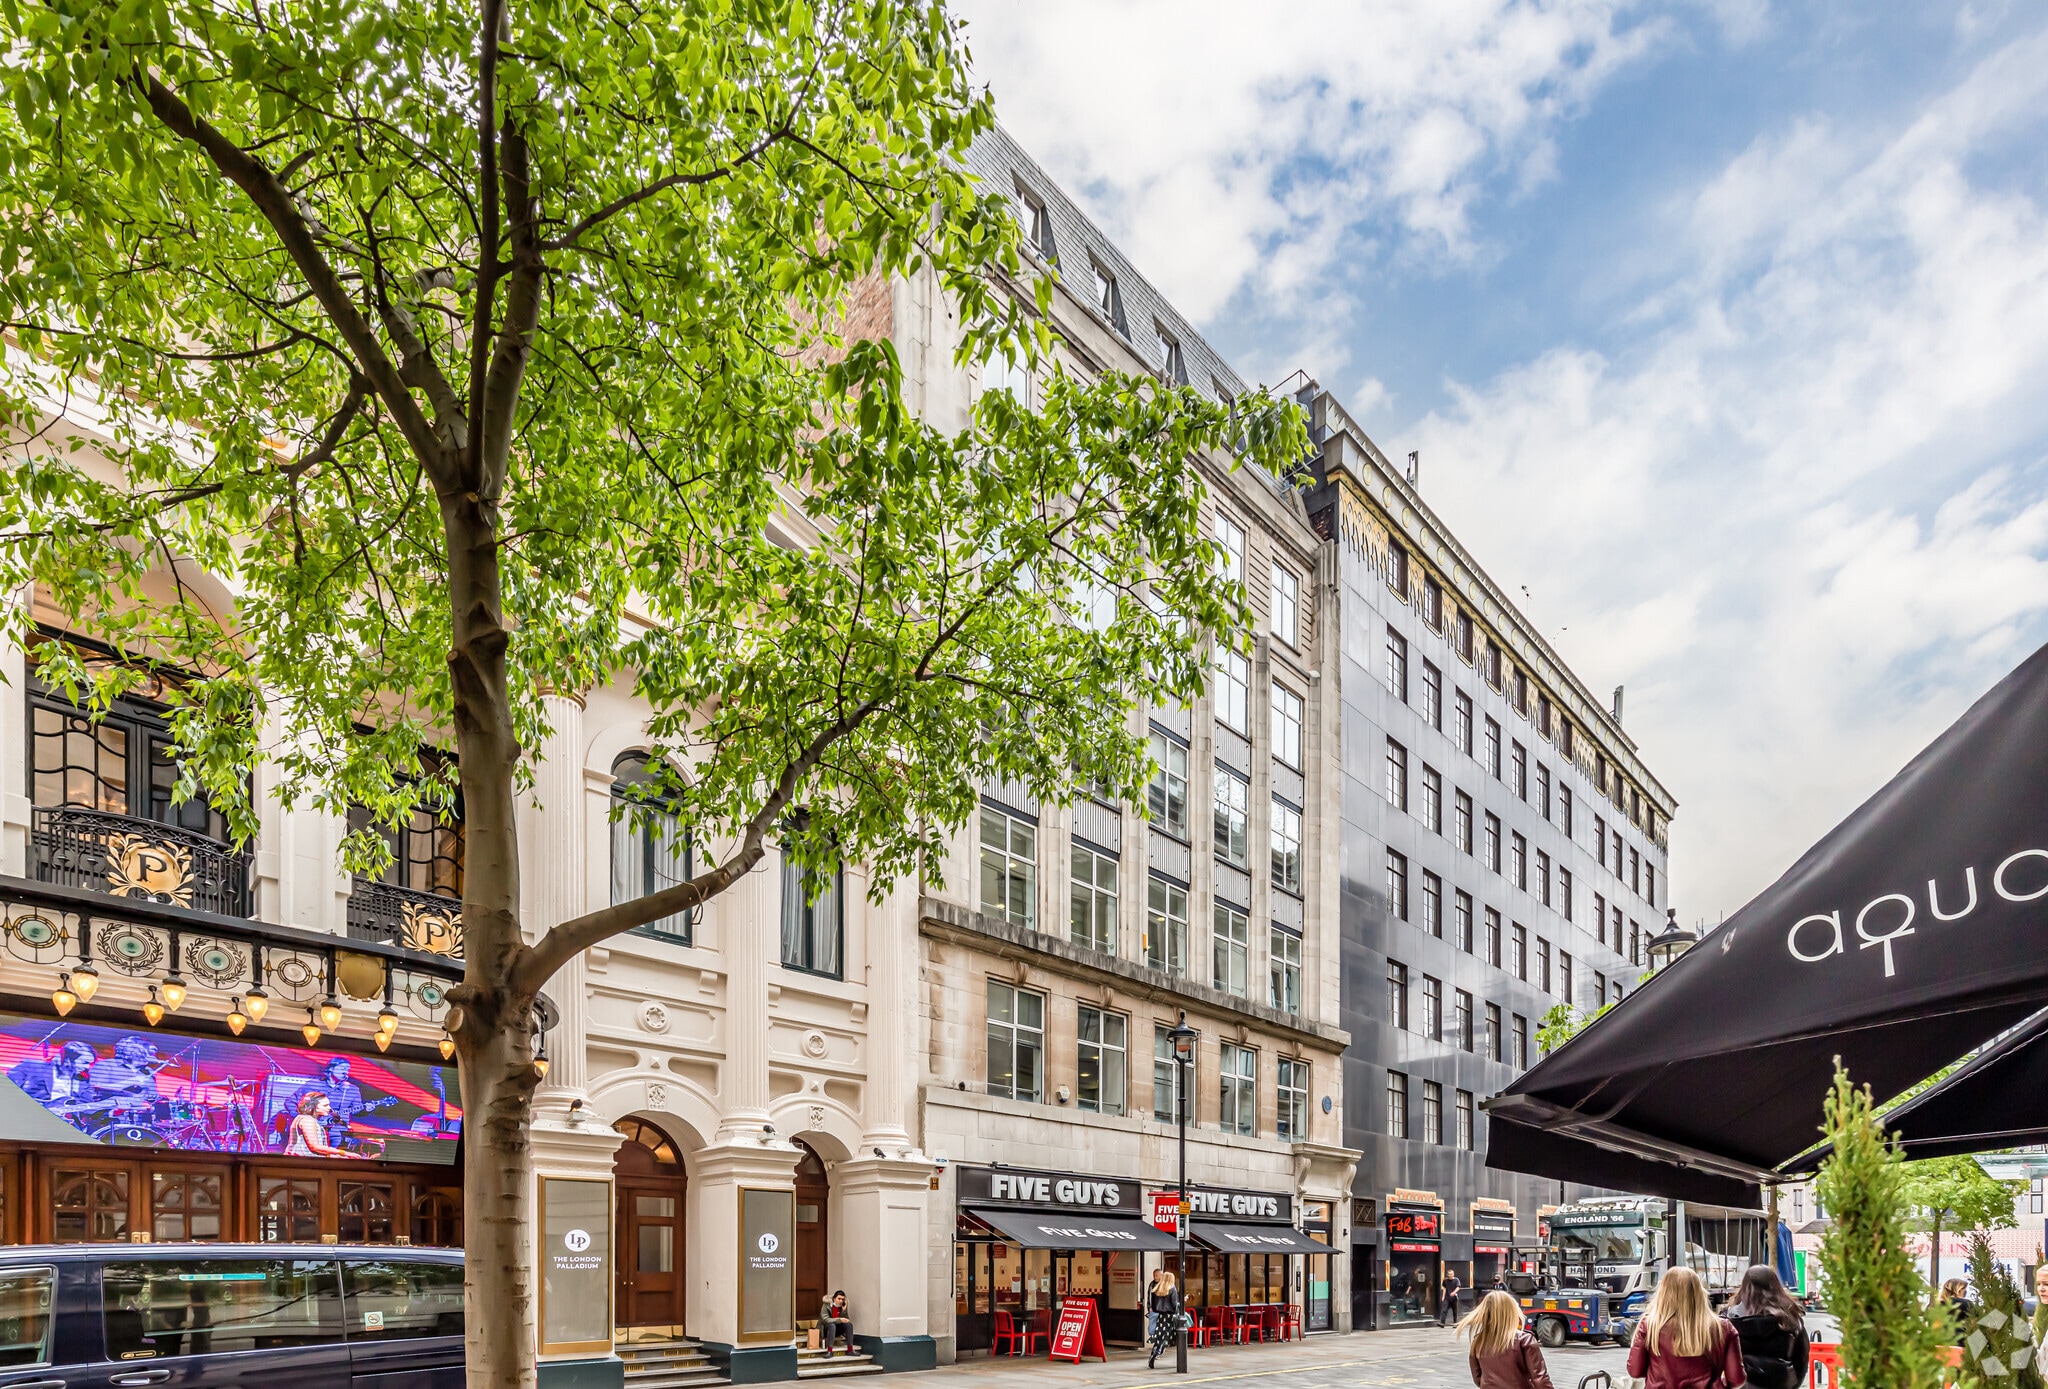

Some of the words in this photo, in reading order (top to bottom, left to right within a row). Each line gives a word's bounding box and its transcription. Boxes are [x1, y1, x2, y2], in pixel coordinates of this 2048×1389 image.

[138, 853, 168, 883] P
[423, 921, 447, 945] P
[127, 1129, 142, 1140] Q
[991, 1174, 1050, 1201] FIVE
[1055, 1179, 1120, 1206] GUYS
[1158, 1205, 1180, 1214] FIVE
[1189, 1191, 1230, 1213] FIVE
[1231, 1195, 1278, 1216] GUYS
[1565, 1216, 1608, 1224] ENGLAND
[1038, 1226, 1088, 1238] FIVE
[1085, 1228, 1137, 1240] GUYS
[1062, 1322, 1082, 1332] OPEN
